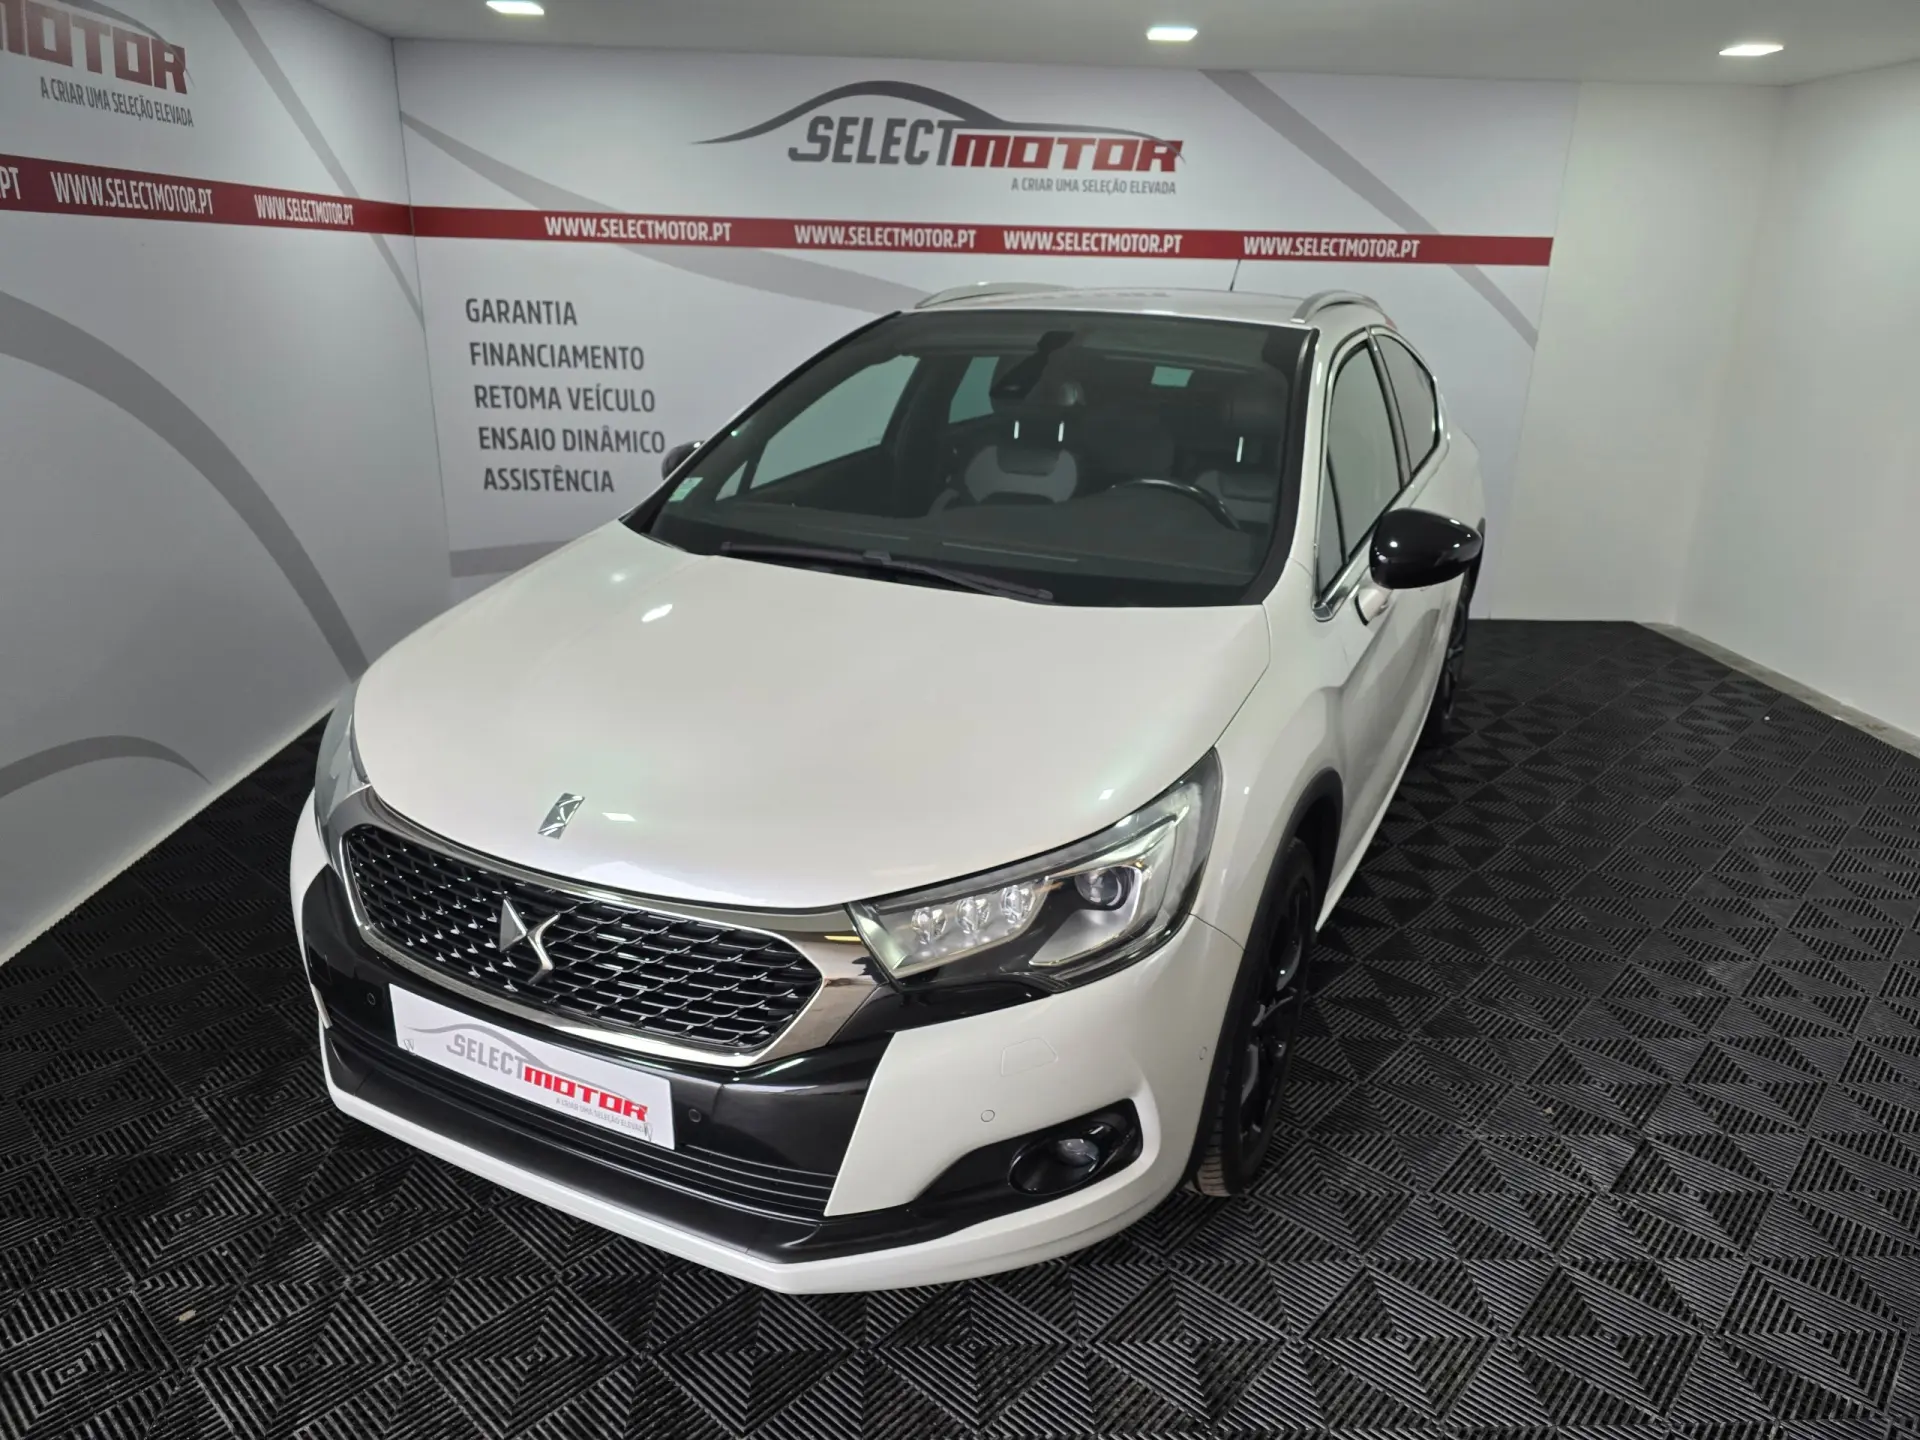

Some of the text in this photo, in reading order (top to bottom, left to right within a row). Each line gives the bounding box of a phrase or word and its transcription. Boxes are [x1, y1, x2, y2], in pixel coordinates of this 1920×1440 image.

[40, 77, 194, 127] A CRIAR UMA SELEÇÃO ELEVADA
[50, 171, 214, 215] WWW.SELECTMOTOR.PT
[254, 194, 354, 226] WWW.SELECTMOTOR.PT
[1011, 178, 1176, 195] A CRIAR UMA SELEÇÃO ELEVADA
[544, 216, 1420, 259] WWW.SELECTMOTOR.PT WWW.SELECTMOTOR.PT WWW.SELECTMOTOR.PT WWW.SELECTMOTOR.PT
[465, 298, 578, 326] GARANTIA
[470, 342, 645, 370] FINANCIAMENTO
[474, 383, 656, 413] RETOMA VEÍCULO
[478, 425, 665, 454] ENSAIO DINÂMICO
[483, 465, 615, 492] ASSISTÊNCIA
